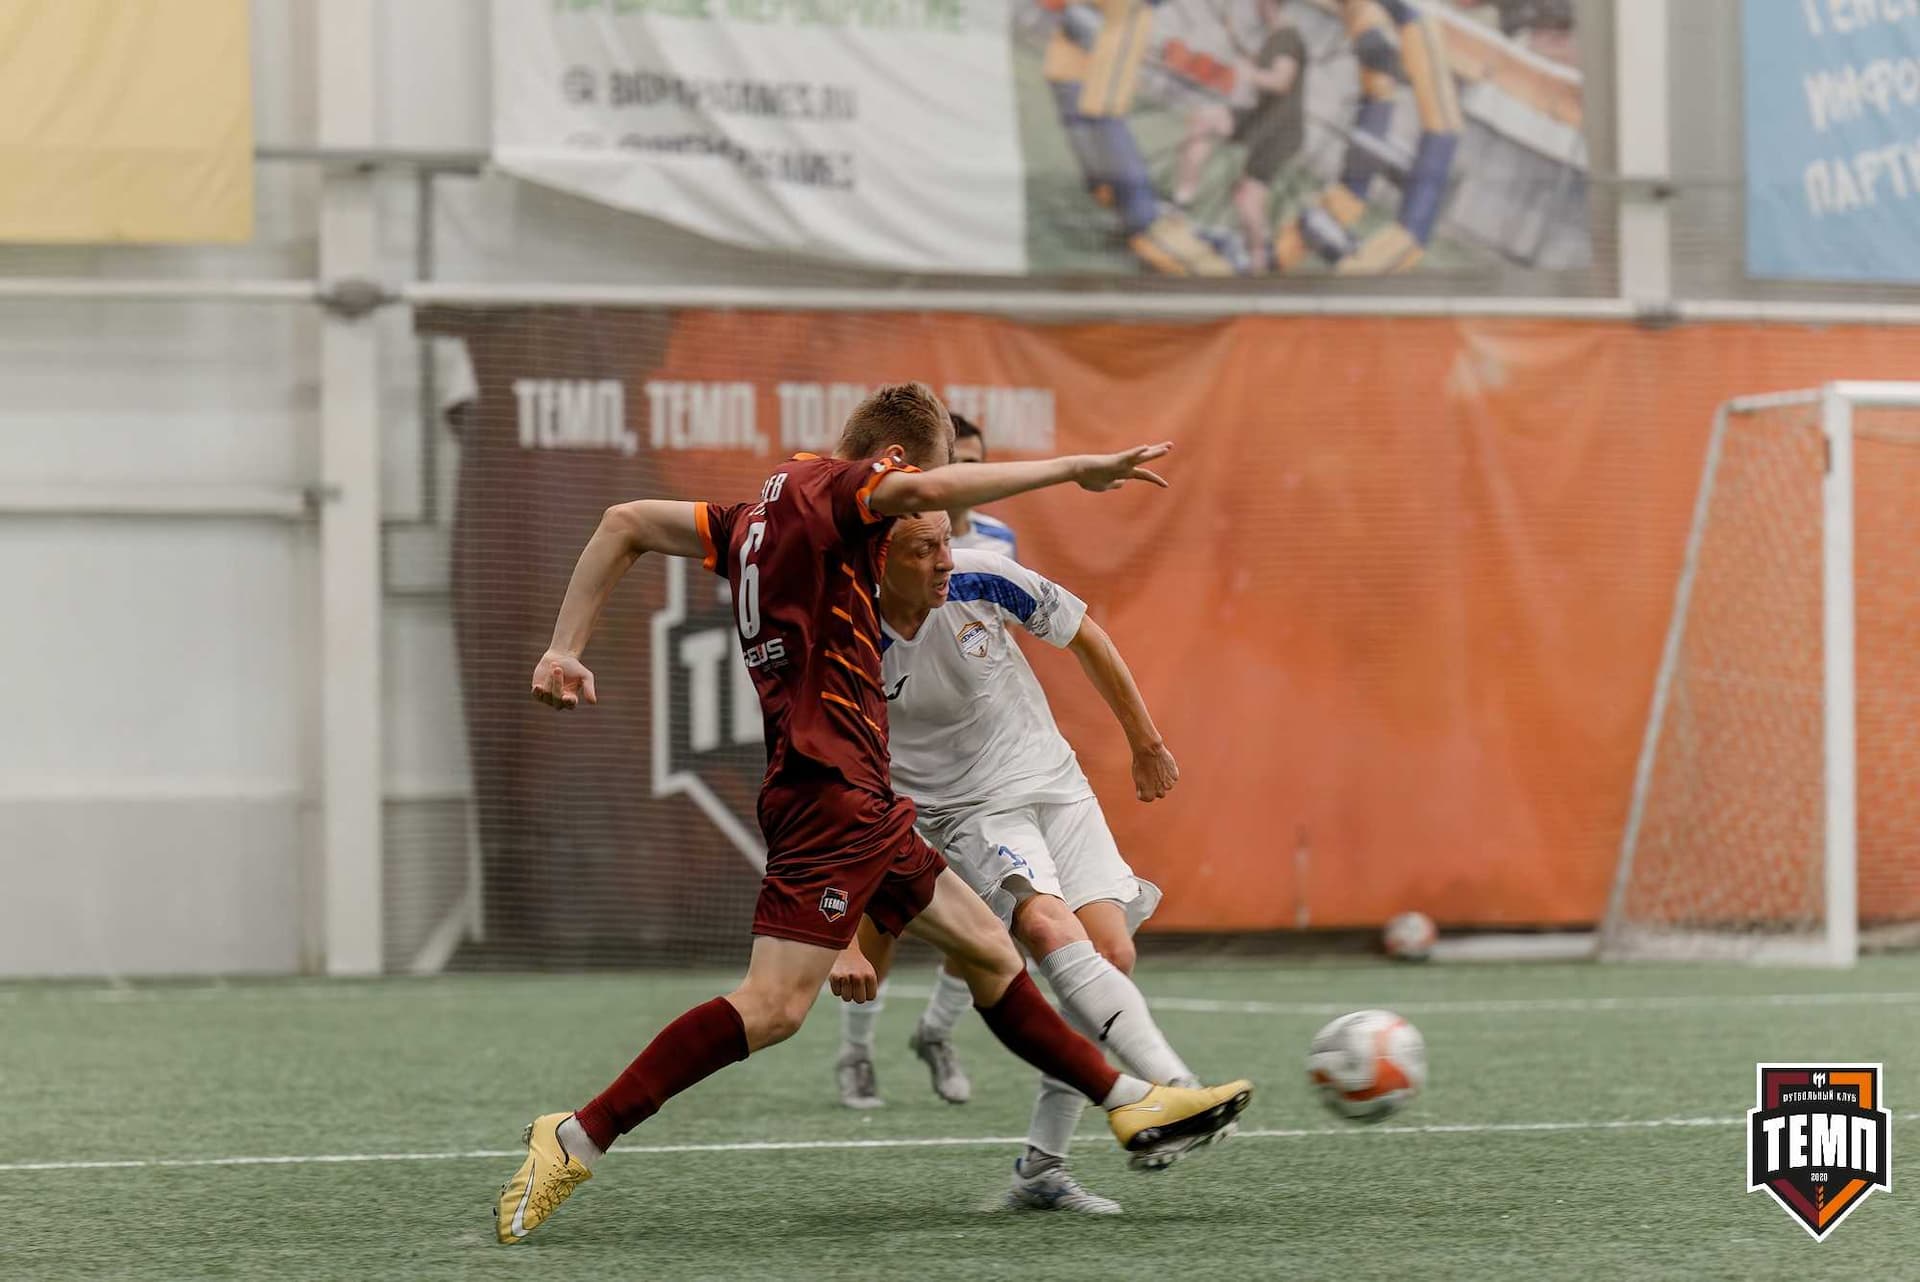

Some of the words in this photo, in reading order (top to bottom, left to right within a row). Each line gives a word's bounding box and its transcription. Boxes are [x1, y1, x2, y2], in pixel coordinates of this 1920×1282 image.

[513, 379, 638, 456] ТЕМП,
[645, 381, 769, 457] ТЕМП,
[739, 521, 768, 639] 6
